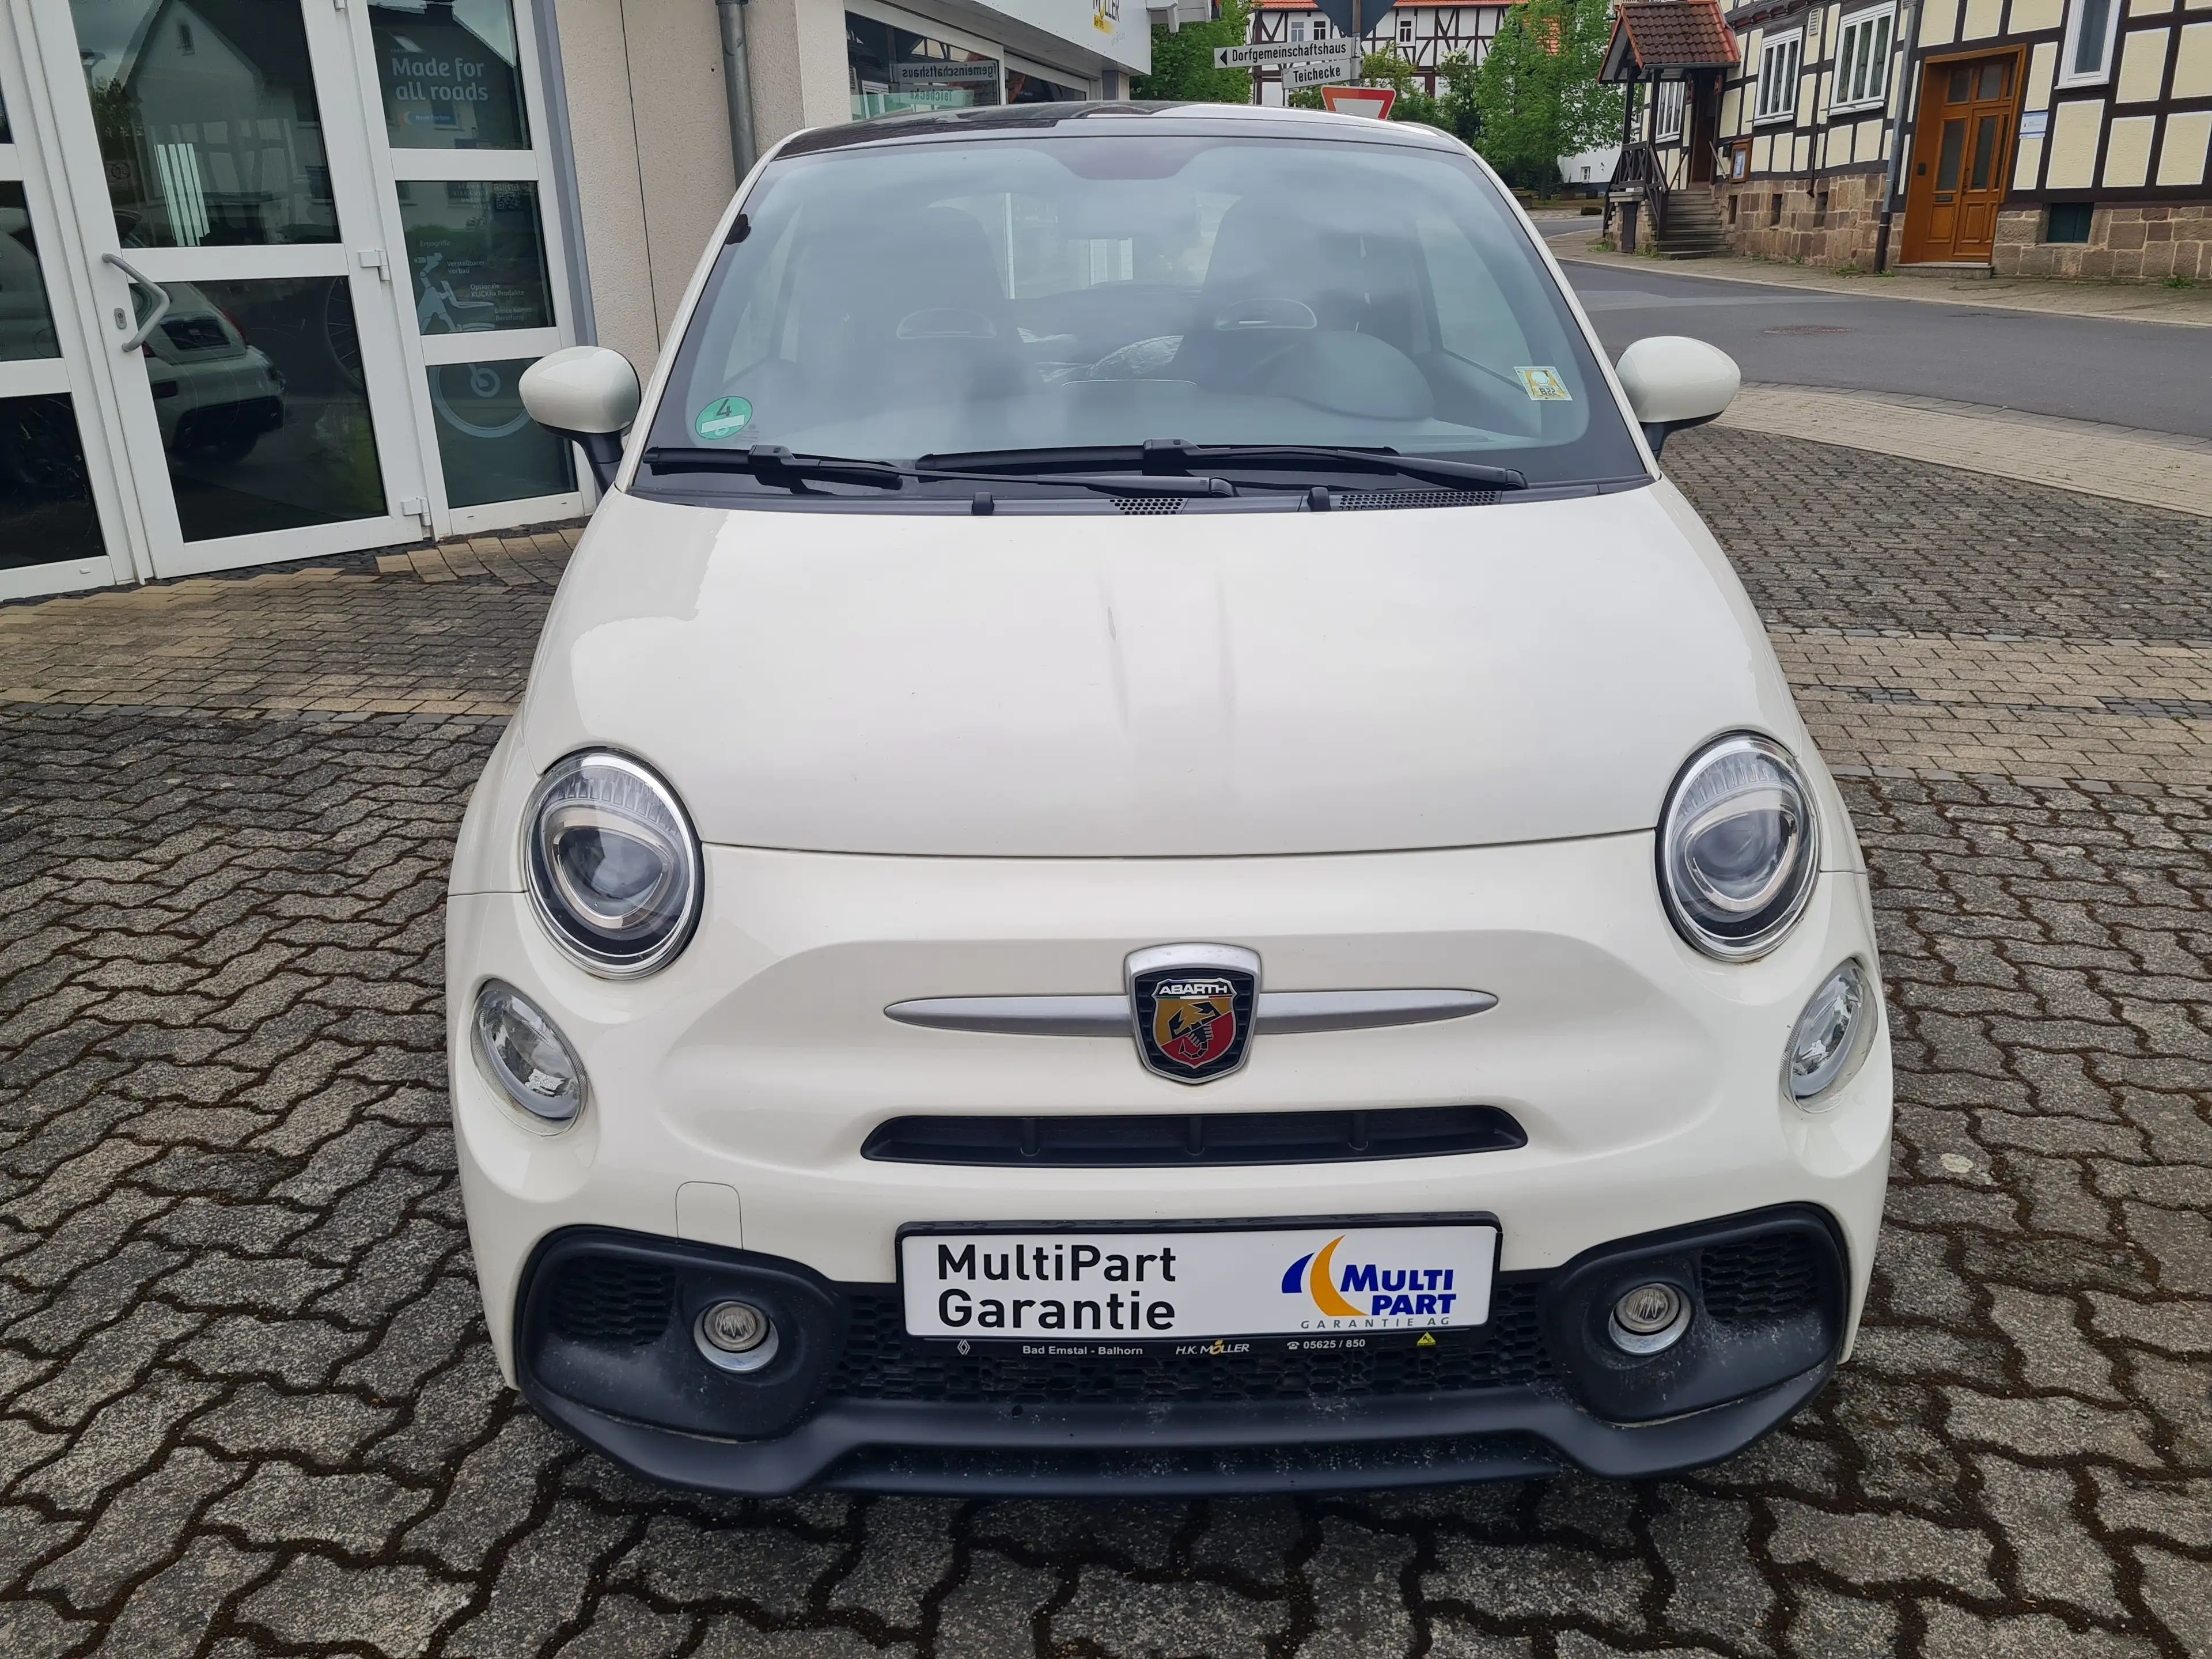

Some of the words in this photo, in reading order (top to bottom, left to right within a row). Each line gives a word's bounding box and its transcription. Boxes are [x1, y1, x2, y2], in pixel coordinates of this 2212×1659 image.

[1232, 43, 1346, 63] Dorfgemeinschaftshaus
[392, 58, 450, 77] Made
[455, 58, 484, 82] for
[1293, 66, 1340, 83] Teichecke
[396, 81, 426, 101] all
[430, 82, 488, 101] roads
[716, 399, 732, 416] 4
[1159, 984, 1228, 994] ABARTH
[938, 1244, 1176, 1282] MultiPart
[938, 1288, 1175, 1331] Garantie
[1372, 1294, 1456, 1316] PART
[1301, 1318, 1414, 1330] GARANTIE
[1427, 1317, 1449, 1325] AG
[1022, 1346, 1045, 1354] Bad
[1048, 1346, 1088, 1354] Emstal
[1098, 1347, 1143, 1355] Balhorn
[1176, 1345, 1198, 1355] H.K.
[1303, 1339, 1336, 1349] 05625
[1346, 1339, 1365, 1348] 850
